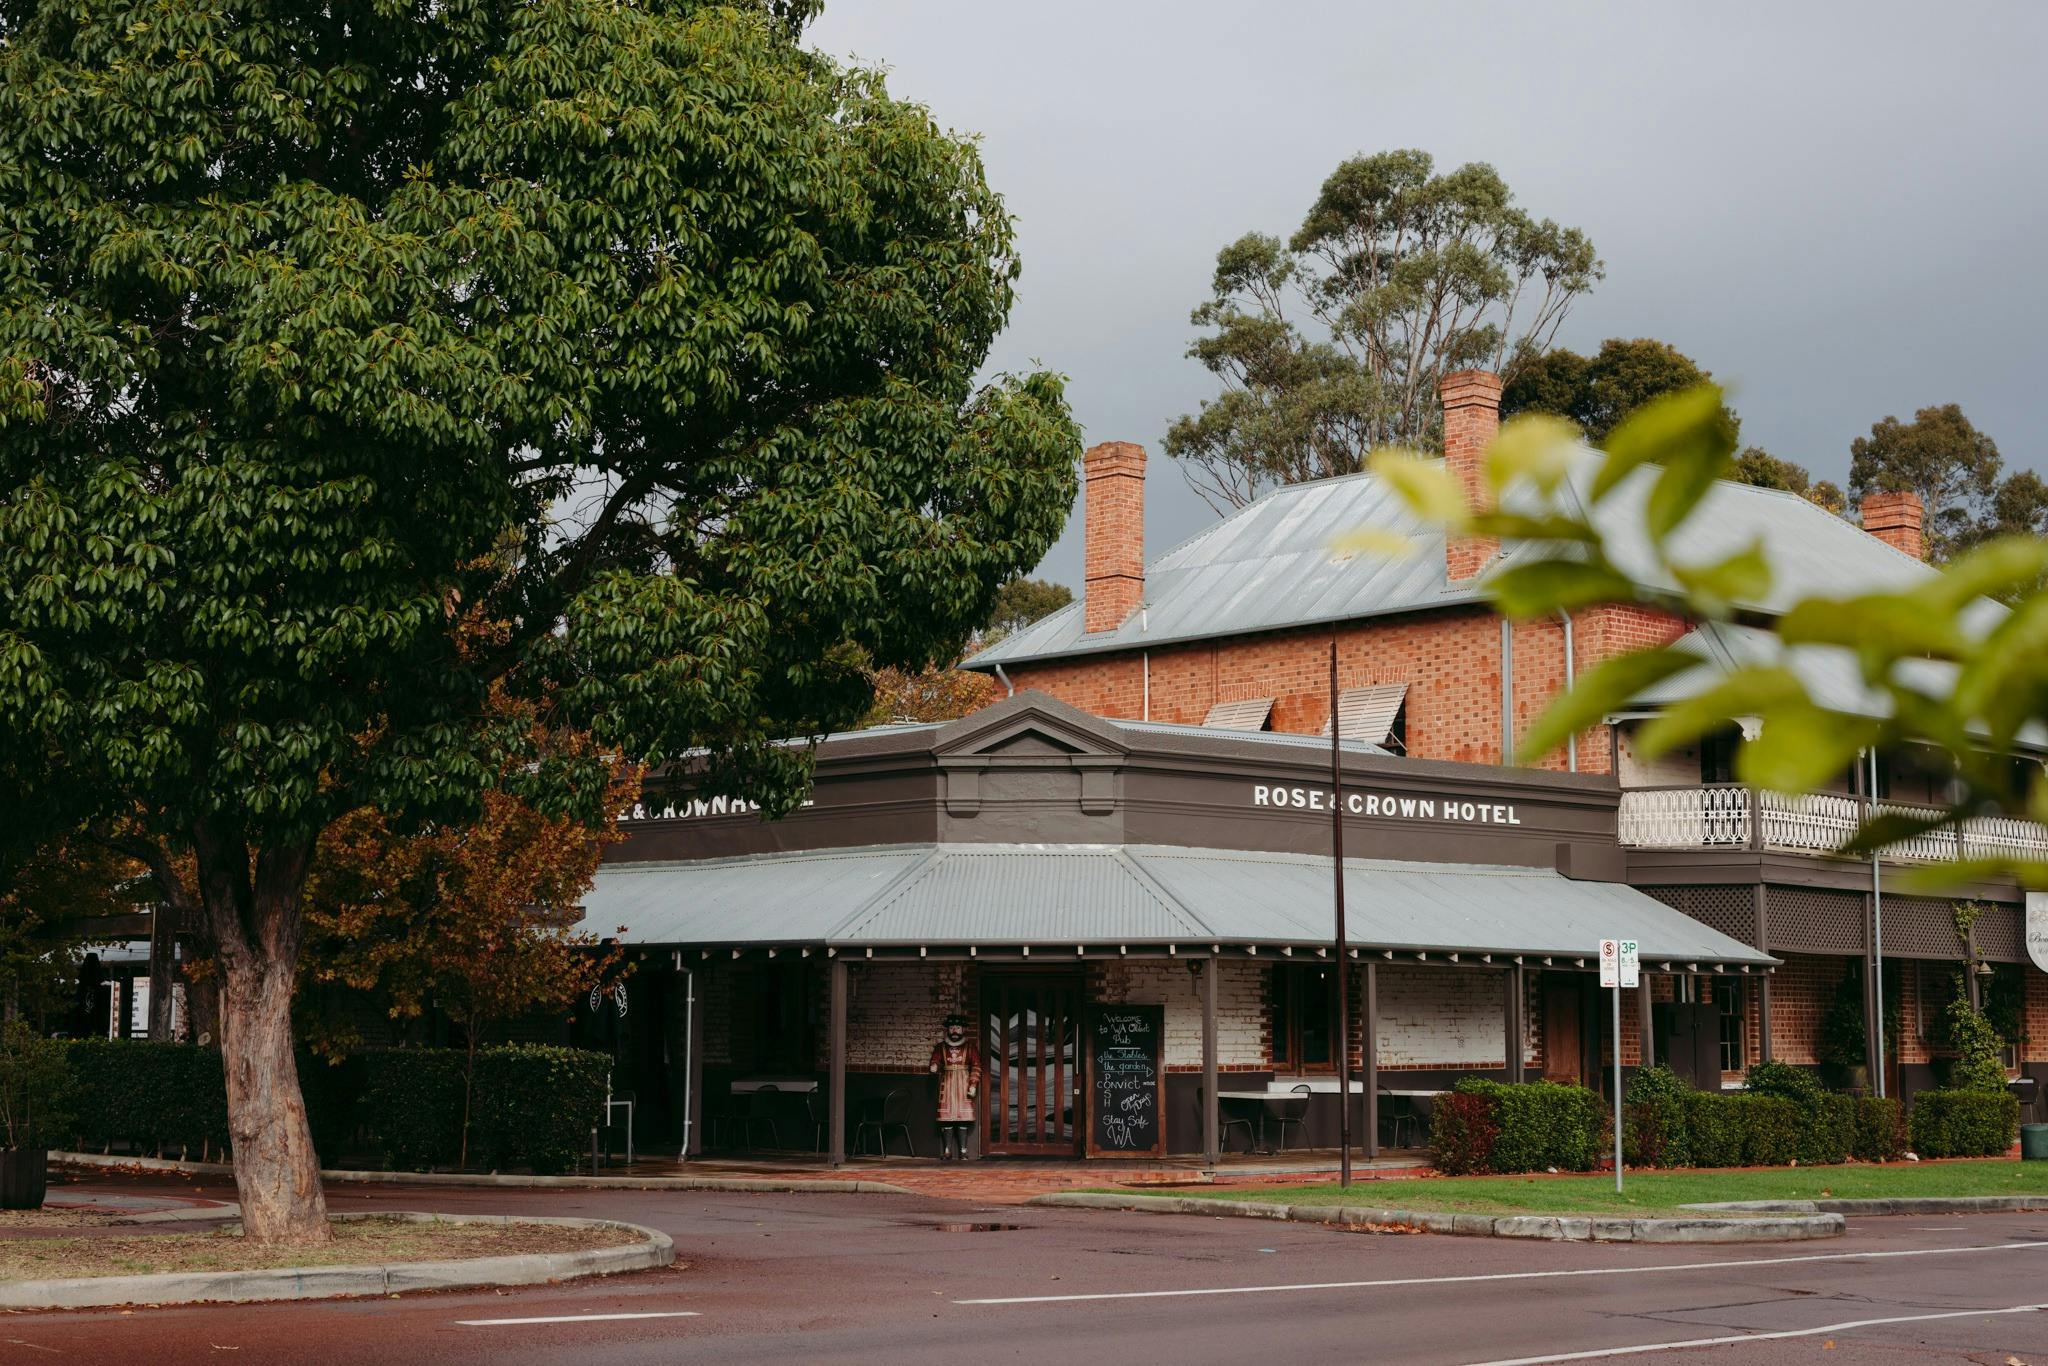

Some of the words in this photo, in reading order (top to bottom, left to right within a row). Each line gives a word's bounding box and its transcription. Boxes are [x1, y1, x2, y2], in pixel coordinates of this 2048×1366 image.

[632, 803, 645, 820] &
[1254, 785, 1324, 810] ROSE
[1348, 794, 1435, 818] CROWN
[1444, 801, 1520, 824] HOTEL
[1622, 943, 1636, 954] 3P
[1098, 1024, 1108, 1034] to
[1111, 1023, 1126, 1034] WA
[1112, 1034, 1131, 1044] Pub
[1103, 1061, 1115, 1071] the
[1118, 1061, 1146, 1075] garden
[1103, 1115, 1125, 1131] Stay
[1128, 1115, 1149, 1129] Safe
[1106, 1125, 1137, 1149] WA
